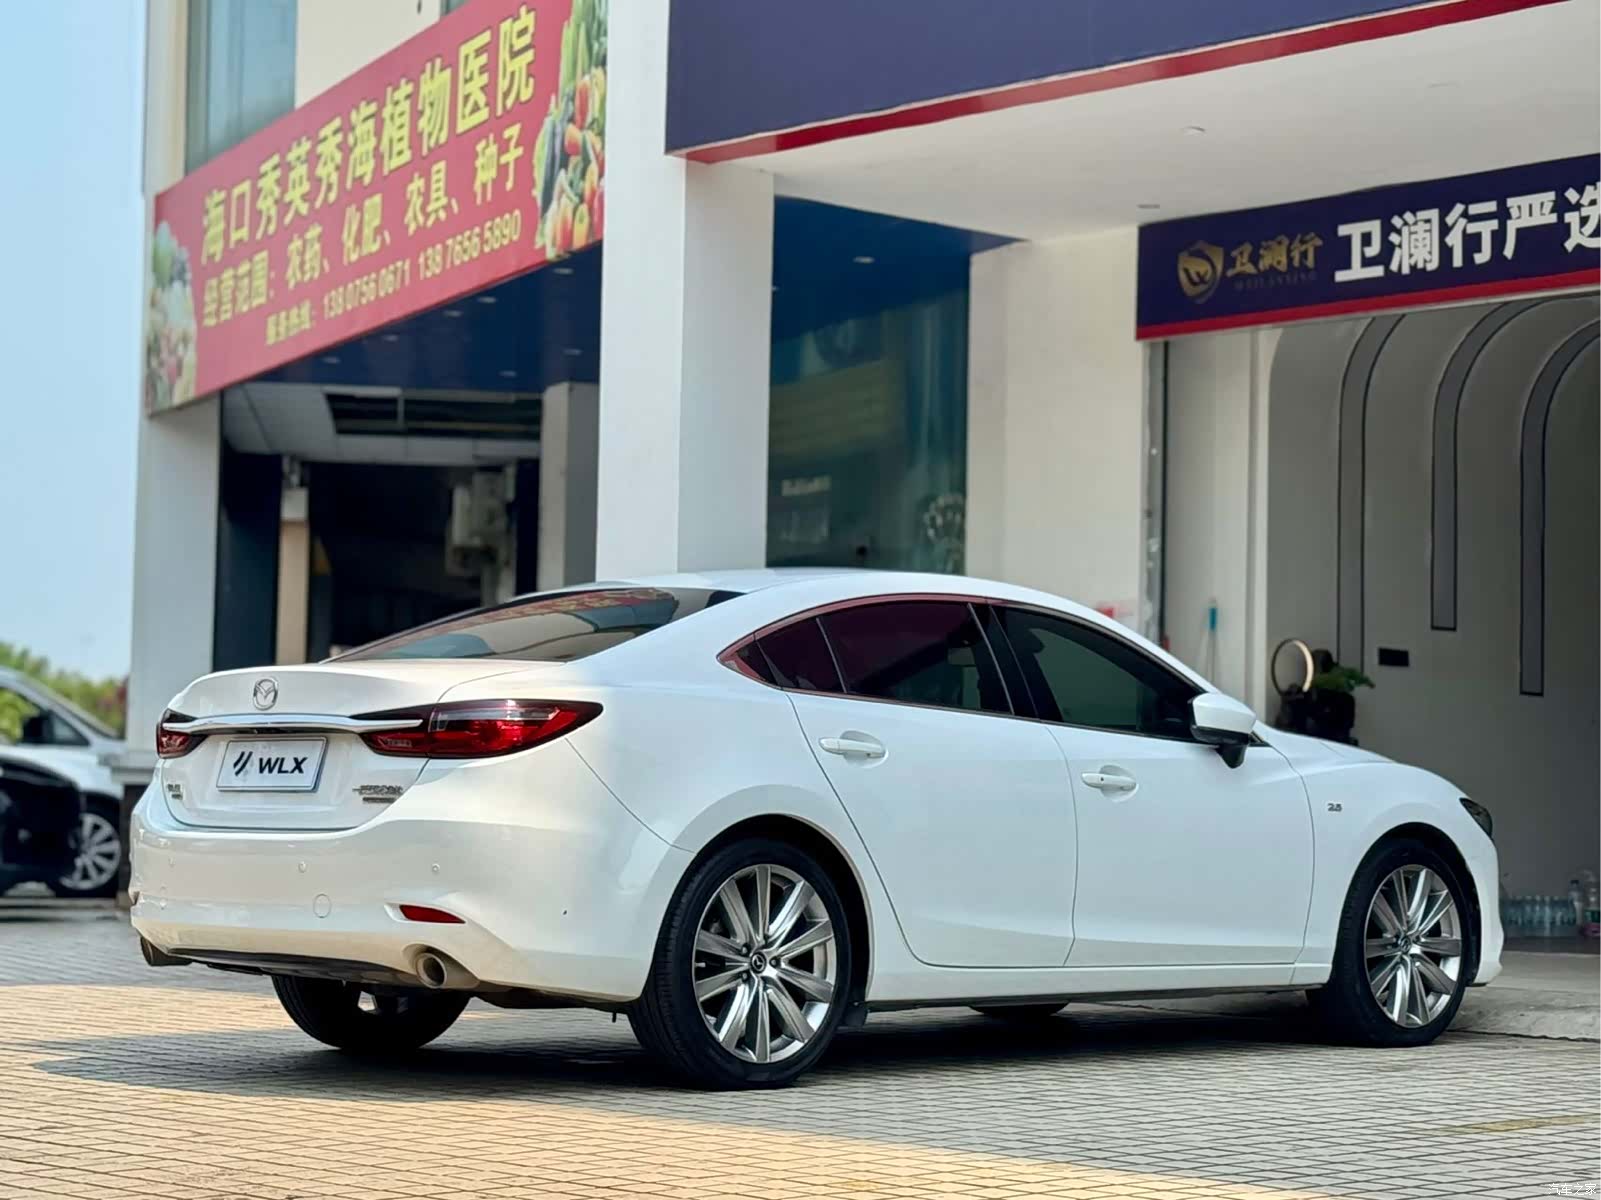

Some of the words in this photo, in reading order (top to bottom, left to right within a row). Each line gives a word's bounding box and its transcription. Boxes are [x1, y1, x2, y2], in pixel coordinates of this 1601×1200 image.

[201, 5, 535, 265] 海口秀英秀海植物医院
[1226, 231, 1324, 277] 卫澜行
[258, 756, 308, 775] WLX
